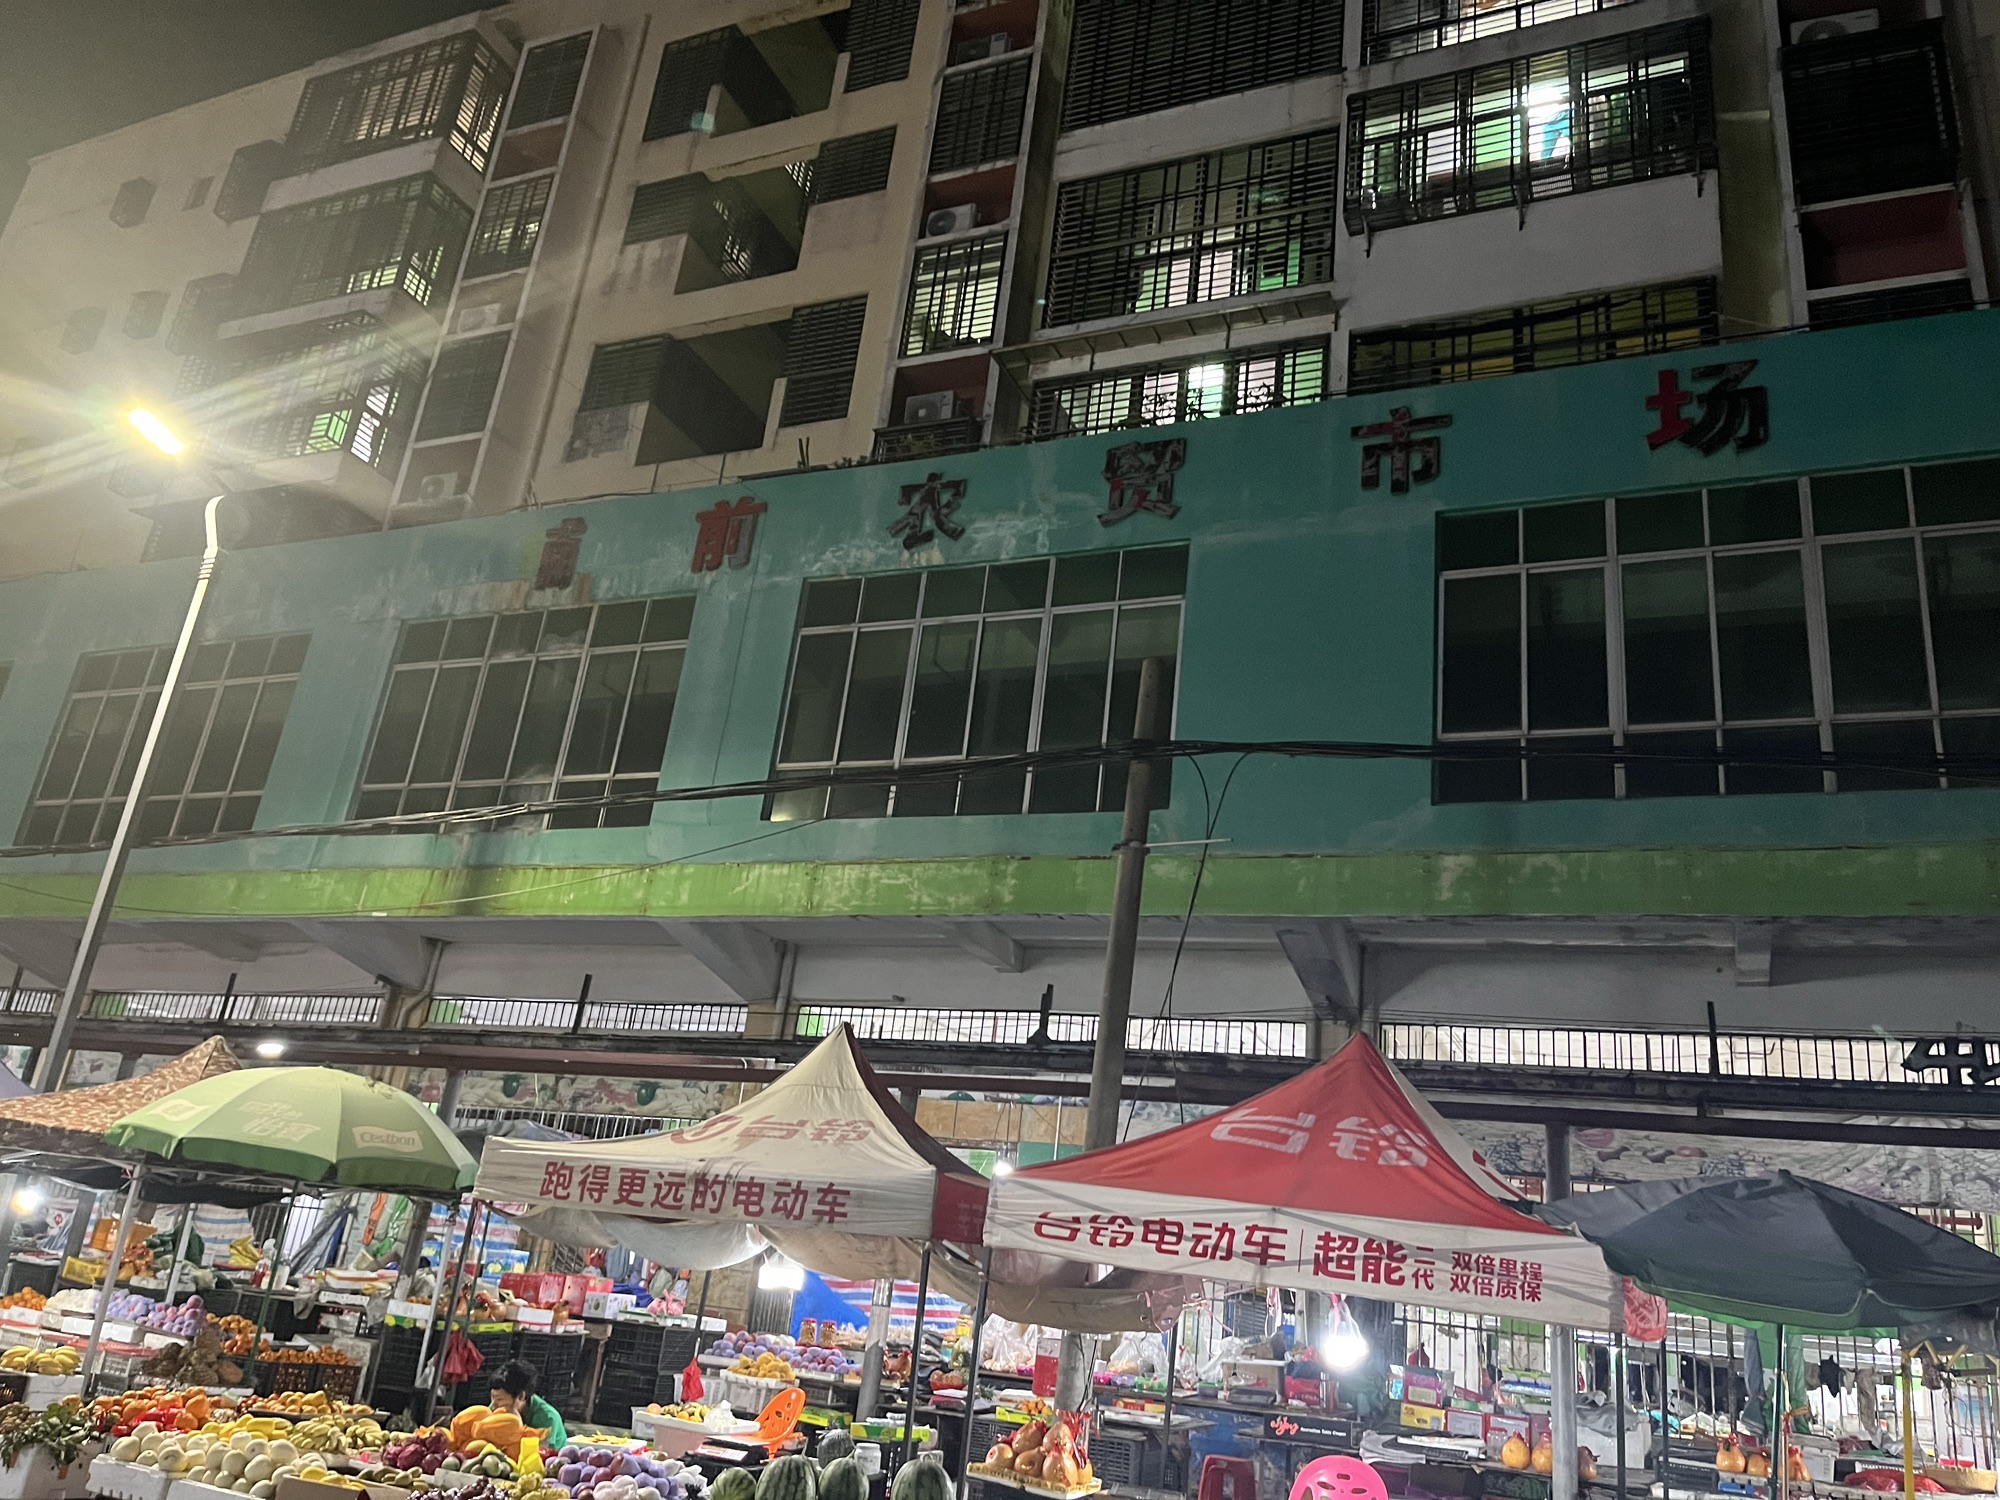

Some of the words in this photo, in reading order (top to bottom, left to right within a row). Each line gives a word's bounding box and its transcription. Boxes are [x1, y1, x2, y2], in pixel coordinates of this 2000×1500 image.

[737, 1114, 876, 1144] 台铃
[1210, 1107, 1429, 1167] 台铃
[539, 1161, 851, 1224] 跑得更远的电动车
[1033, 1211, 1288, 1266] 台铃电动车
[1312, 1231, 1408, 1287] 超能
[1450, 1250, 1543, 1283] 双倍里程
[1449, 1272, 1542, 1303] 双倍质保
